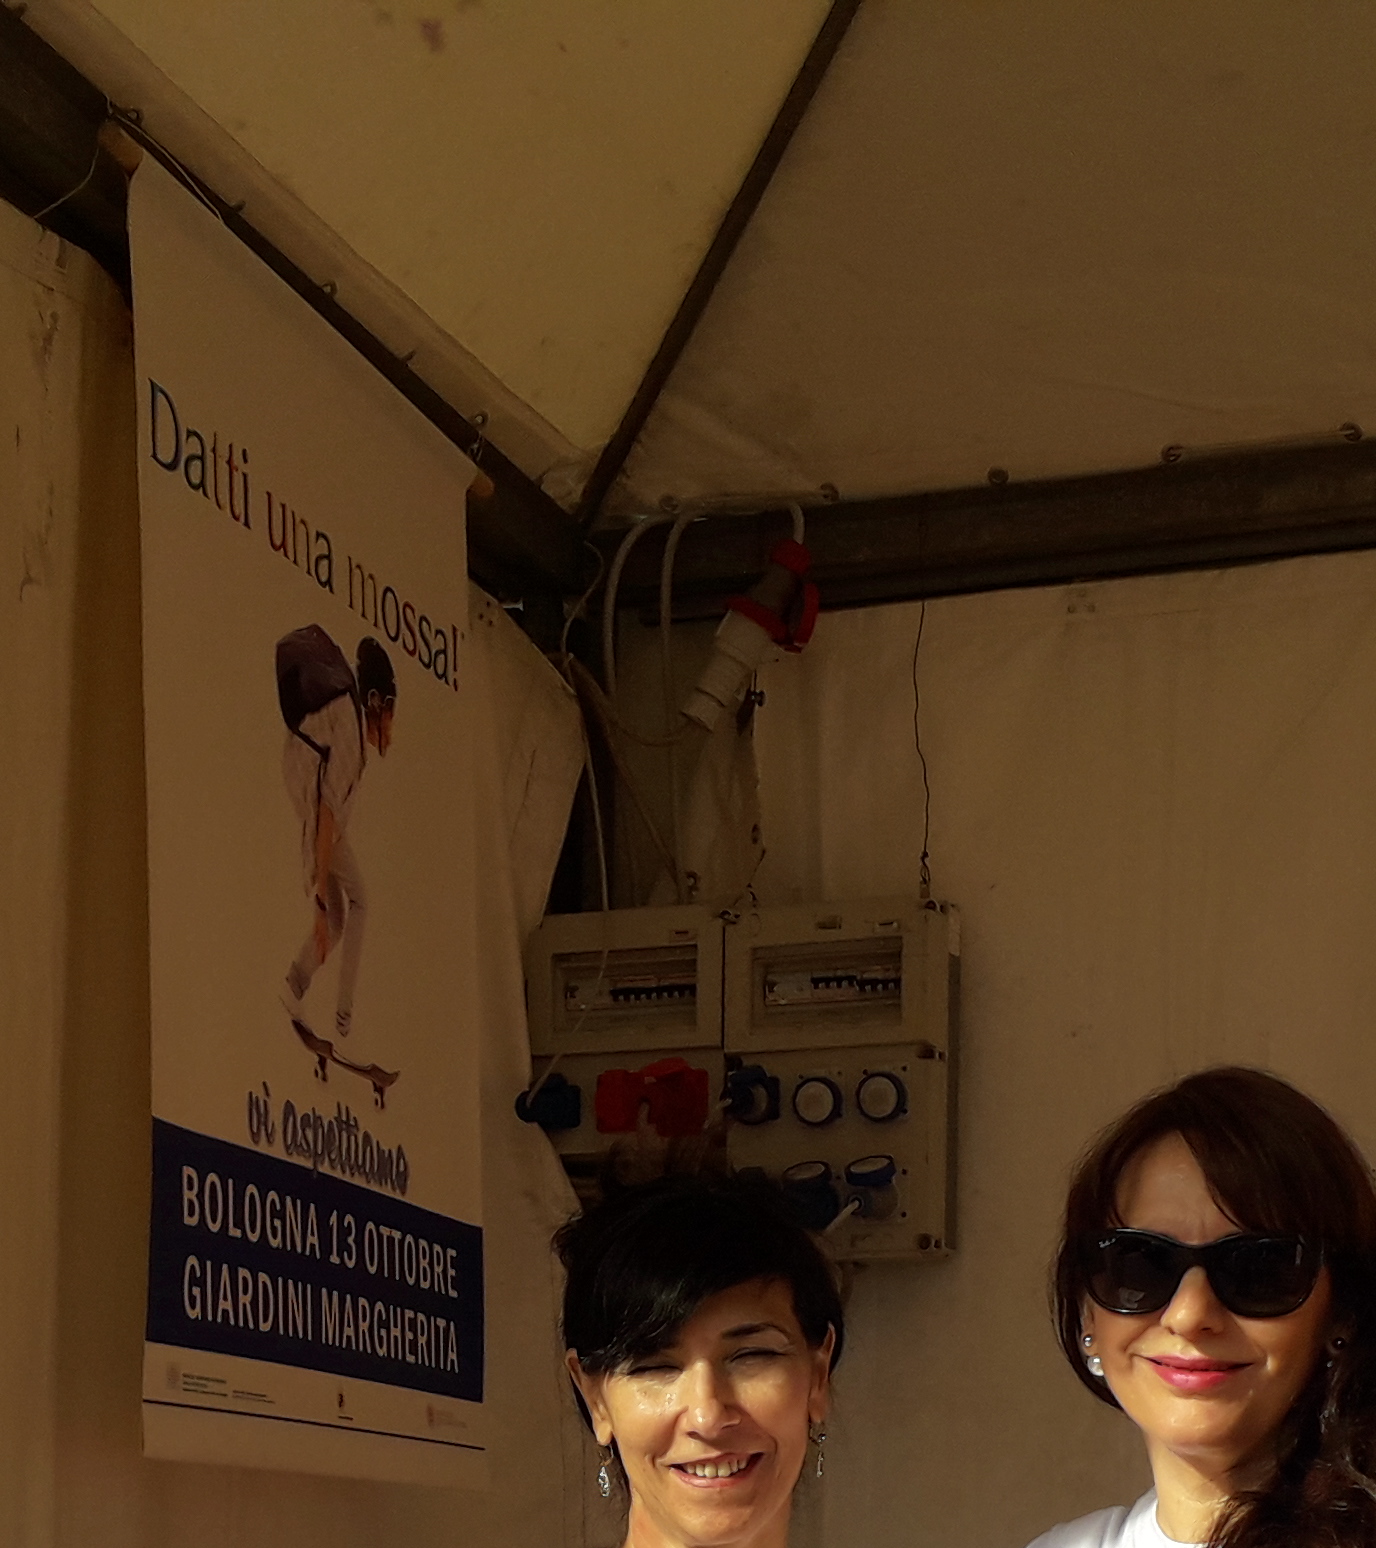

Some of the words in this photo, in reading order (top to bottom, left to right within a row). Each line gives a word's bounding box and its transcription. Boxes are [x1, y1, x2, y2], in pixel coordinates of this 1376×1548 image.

[148, 377, 251, 530] Datti
[266, 491, 335, 594] una
[348, 556, 459, 692] mossa!
[248, 1082, 274, 1146] vi
[282, 1100, 407, 1195] aspettiamo
[182, 1165, 320, 1260] BOLOGNA
[329, 1210, 357, 1268] 13
[364, 1221, 459, 1298] OTTOBRE
[183, 1255, 312, 1341] GIARDINI
[321, 1287, 459, 1374] MARGHERITA
